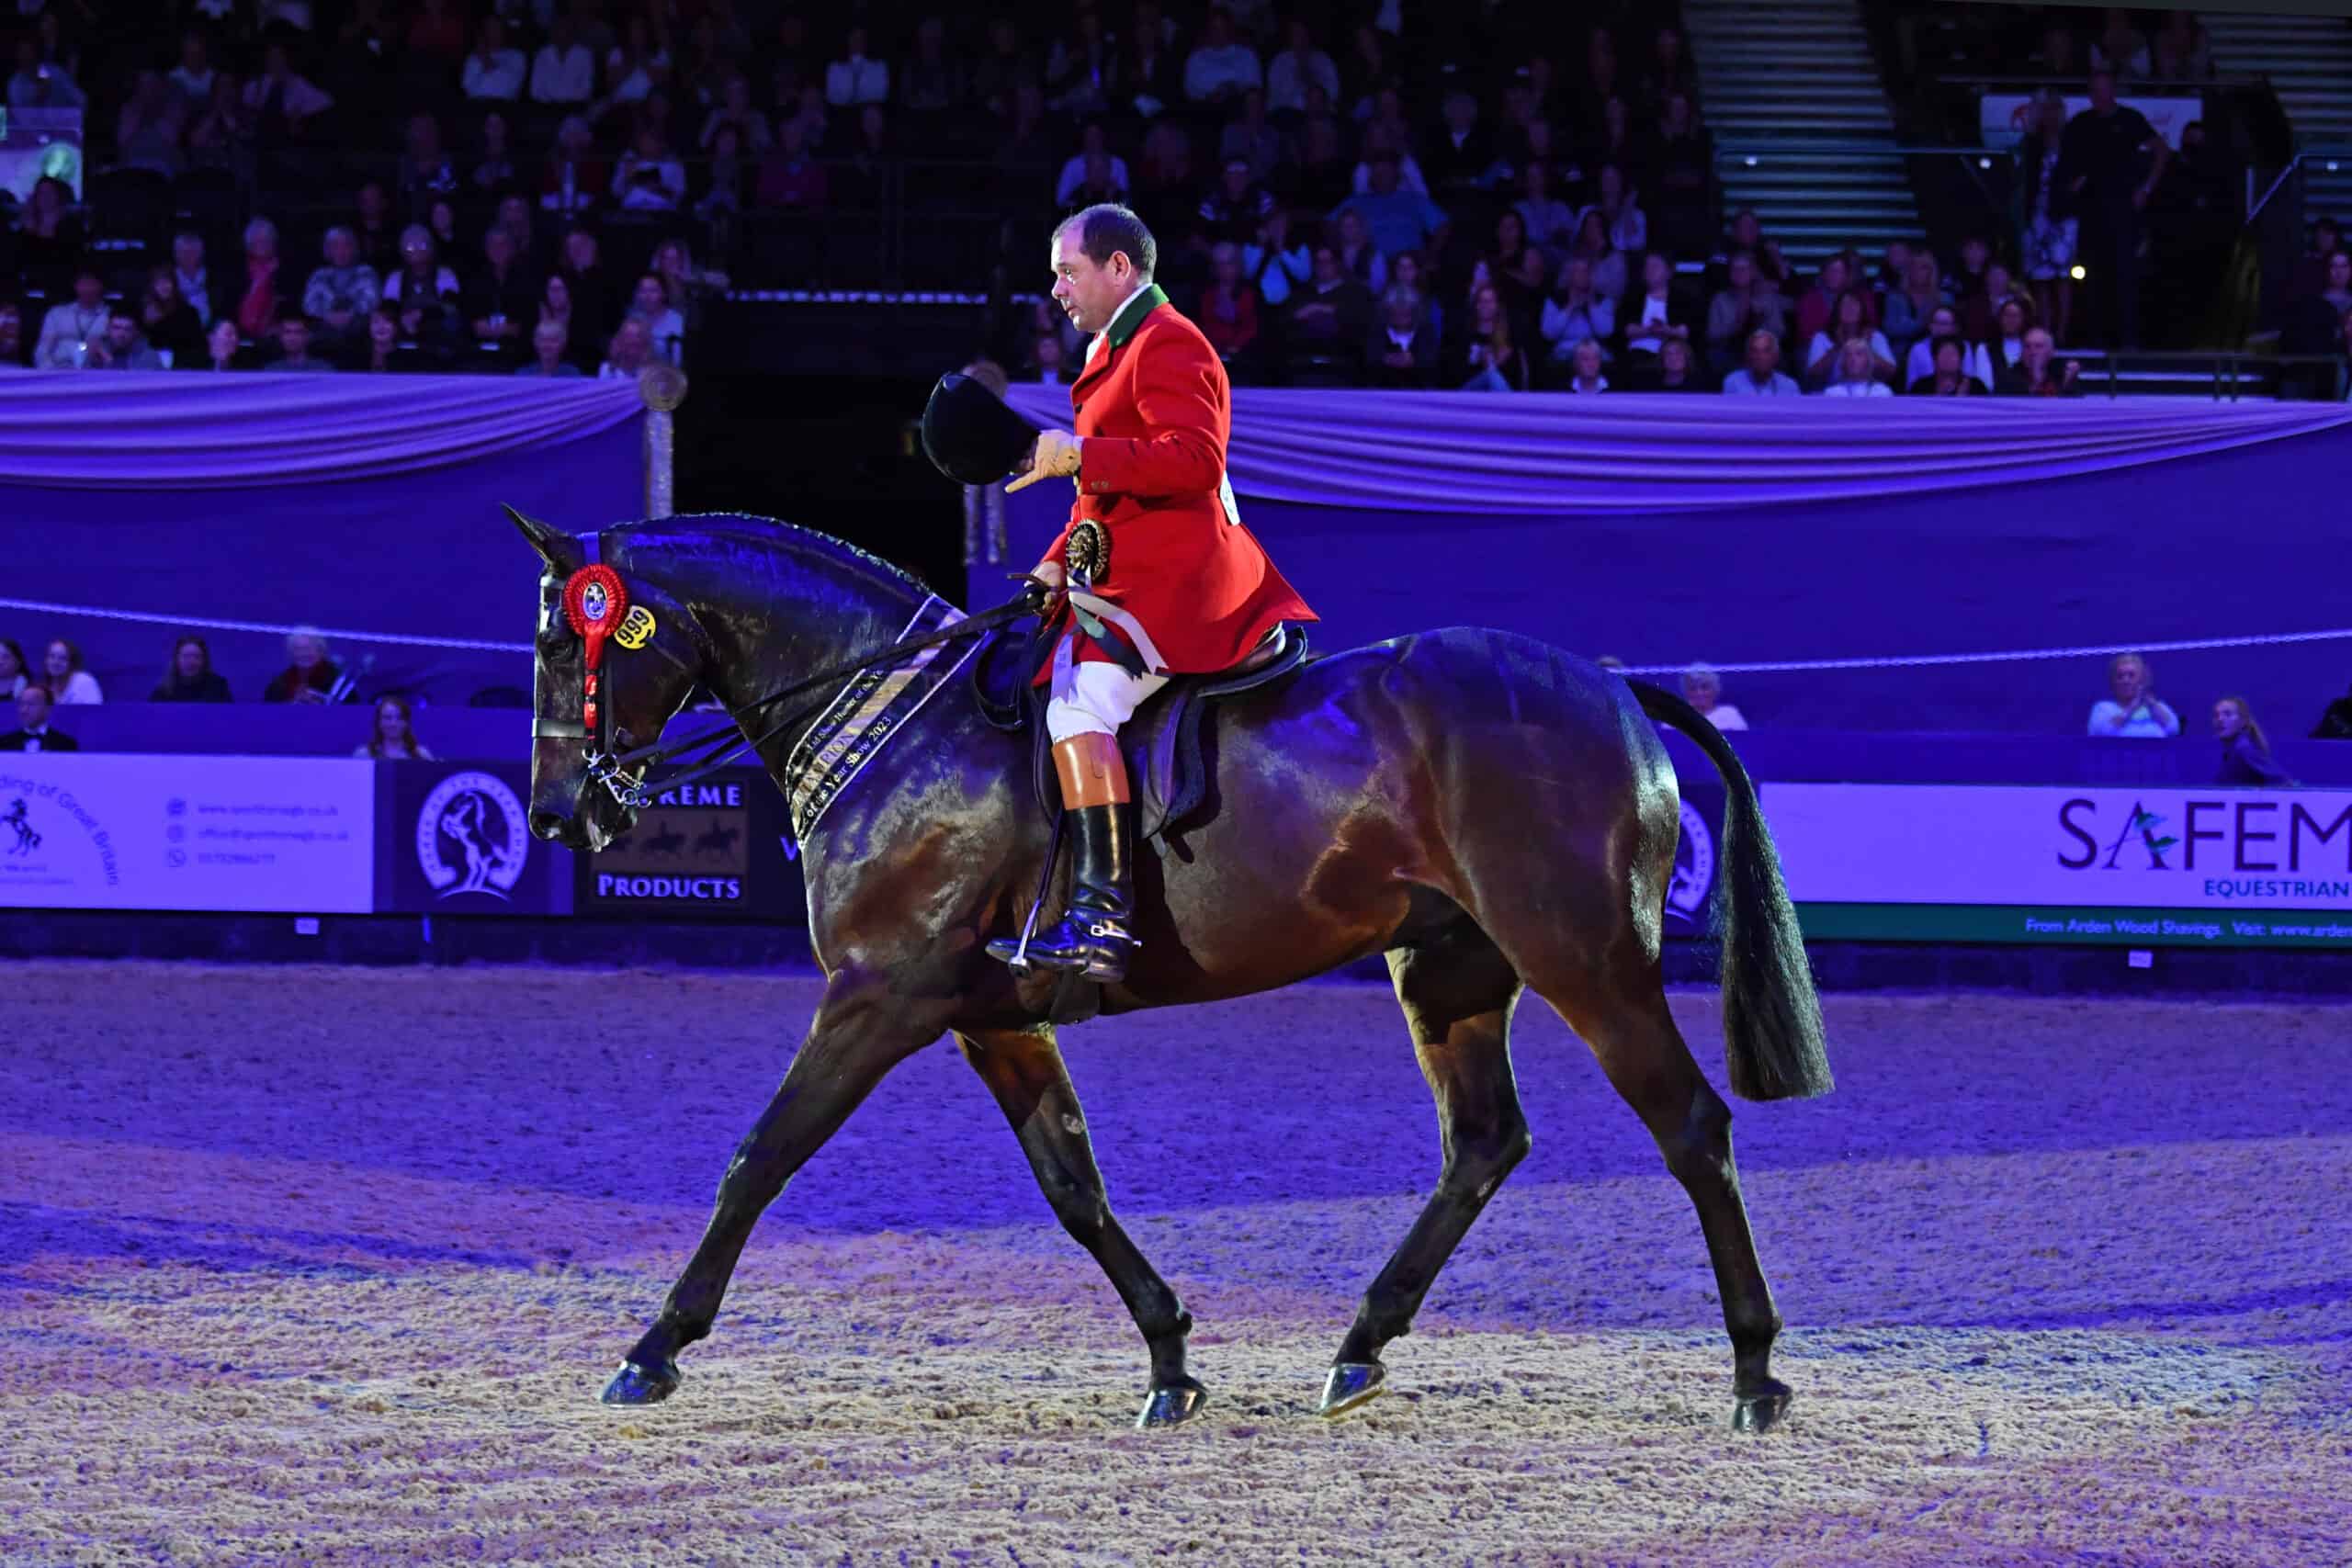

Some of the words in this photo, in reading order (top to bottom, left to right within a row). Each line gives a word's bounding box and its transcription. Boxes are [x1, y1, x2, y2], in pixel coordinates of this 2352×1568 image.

[617, 610, 650, 645] 999
[806, 802, 819, 818] of
[815, 788, 829, 804] the
[825, 765, 848, 790] Year
[844, 740, 872, 767] Show
[867, 716, 892, 743] 2023
[656, 784, 742, 807] REME
[597, 874, 741, 899] PRODUCTS
[2204, 878, 2350, 898] EQUESTRIAN
[2026, 917, 2064, 932] From
[2067, 919, 2112, 934] Arden
[2115, 919, 2159, 935] Wood
